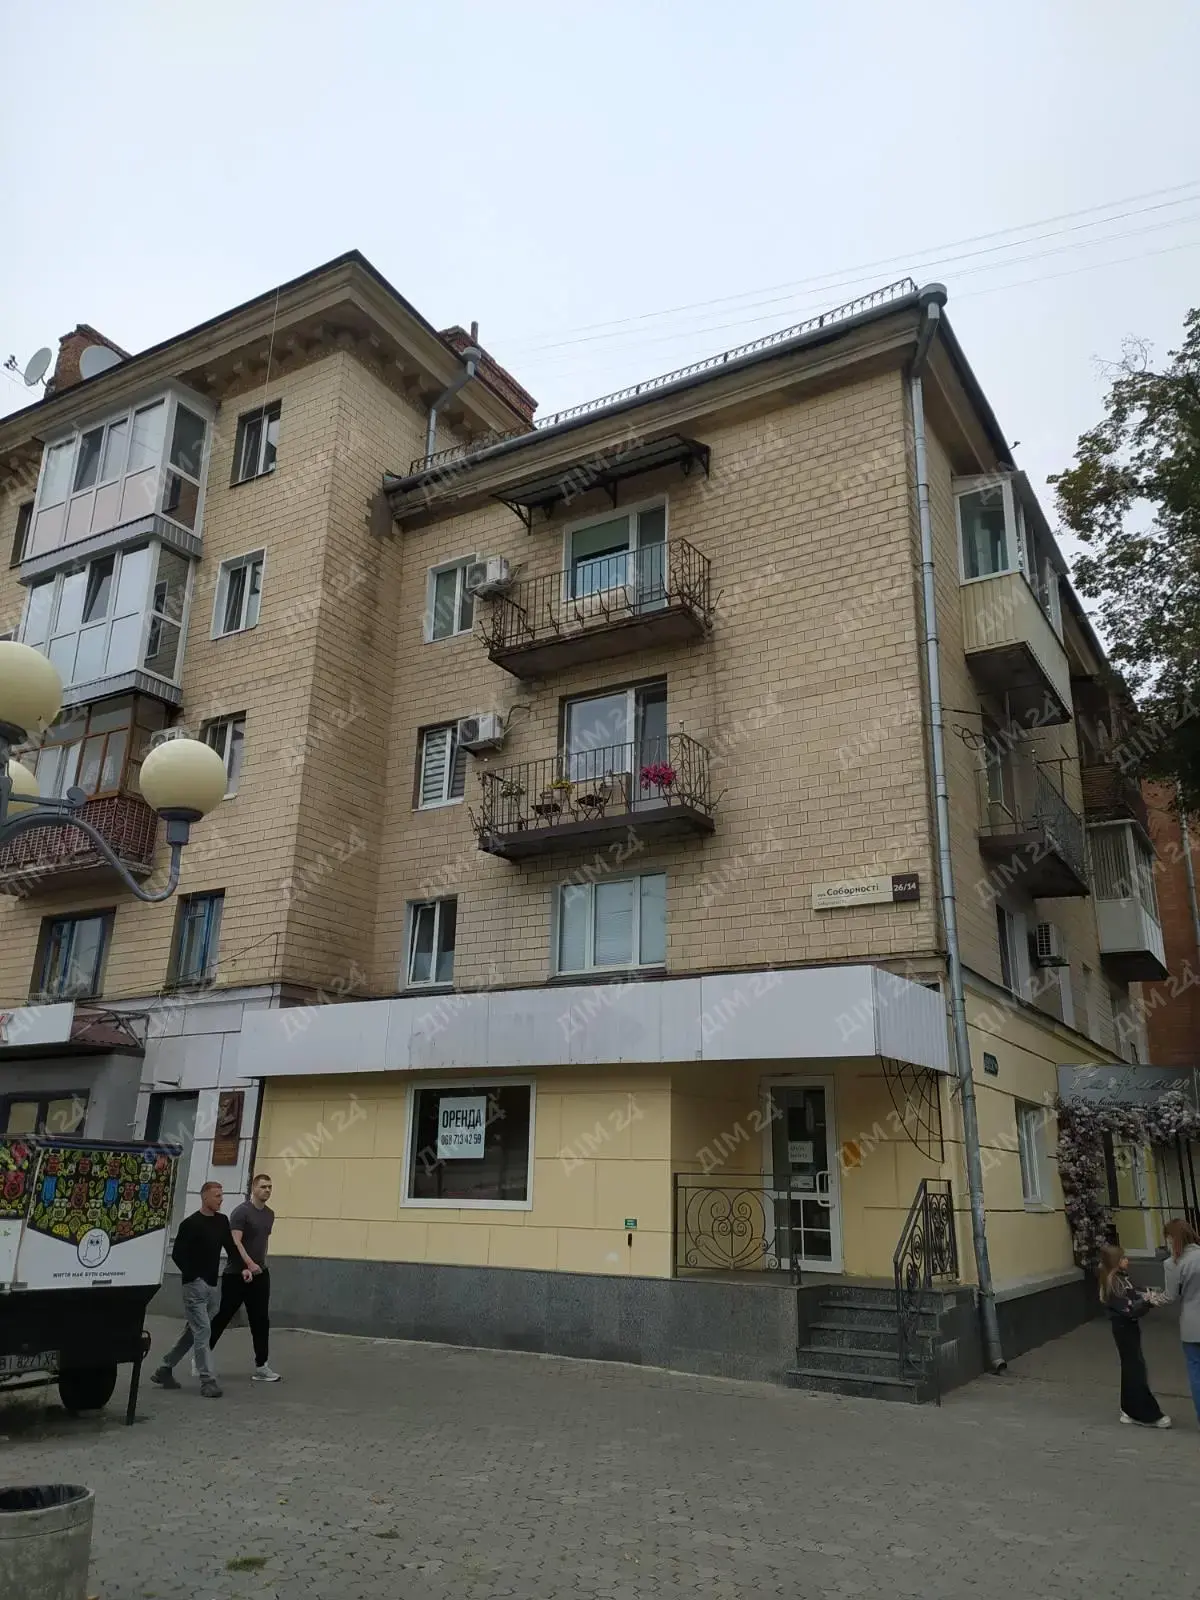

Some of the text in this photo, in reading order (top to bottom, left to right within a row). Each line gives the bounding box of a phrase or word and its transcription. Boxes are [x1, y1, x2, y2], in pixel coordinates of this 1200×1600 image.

[826, 882, 879, 897] Соборності
[893, 881, 917, 893] 26/14
[442, 1108, 482, 1130] ОРЕНДА
